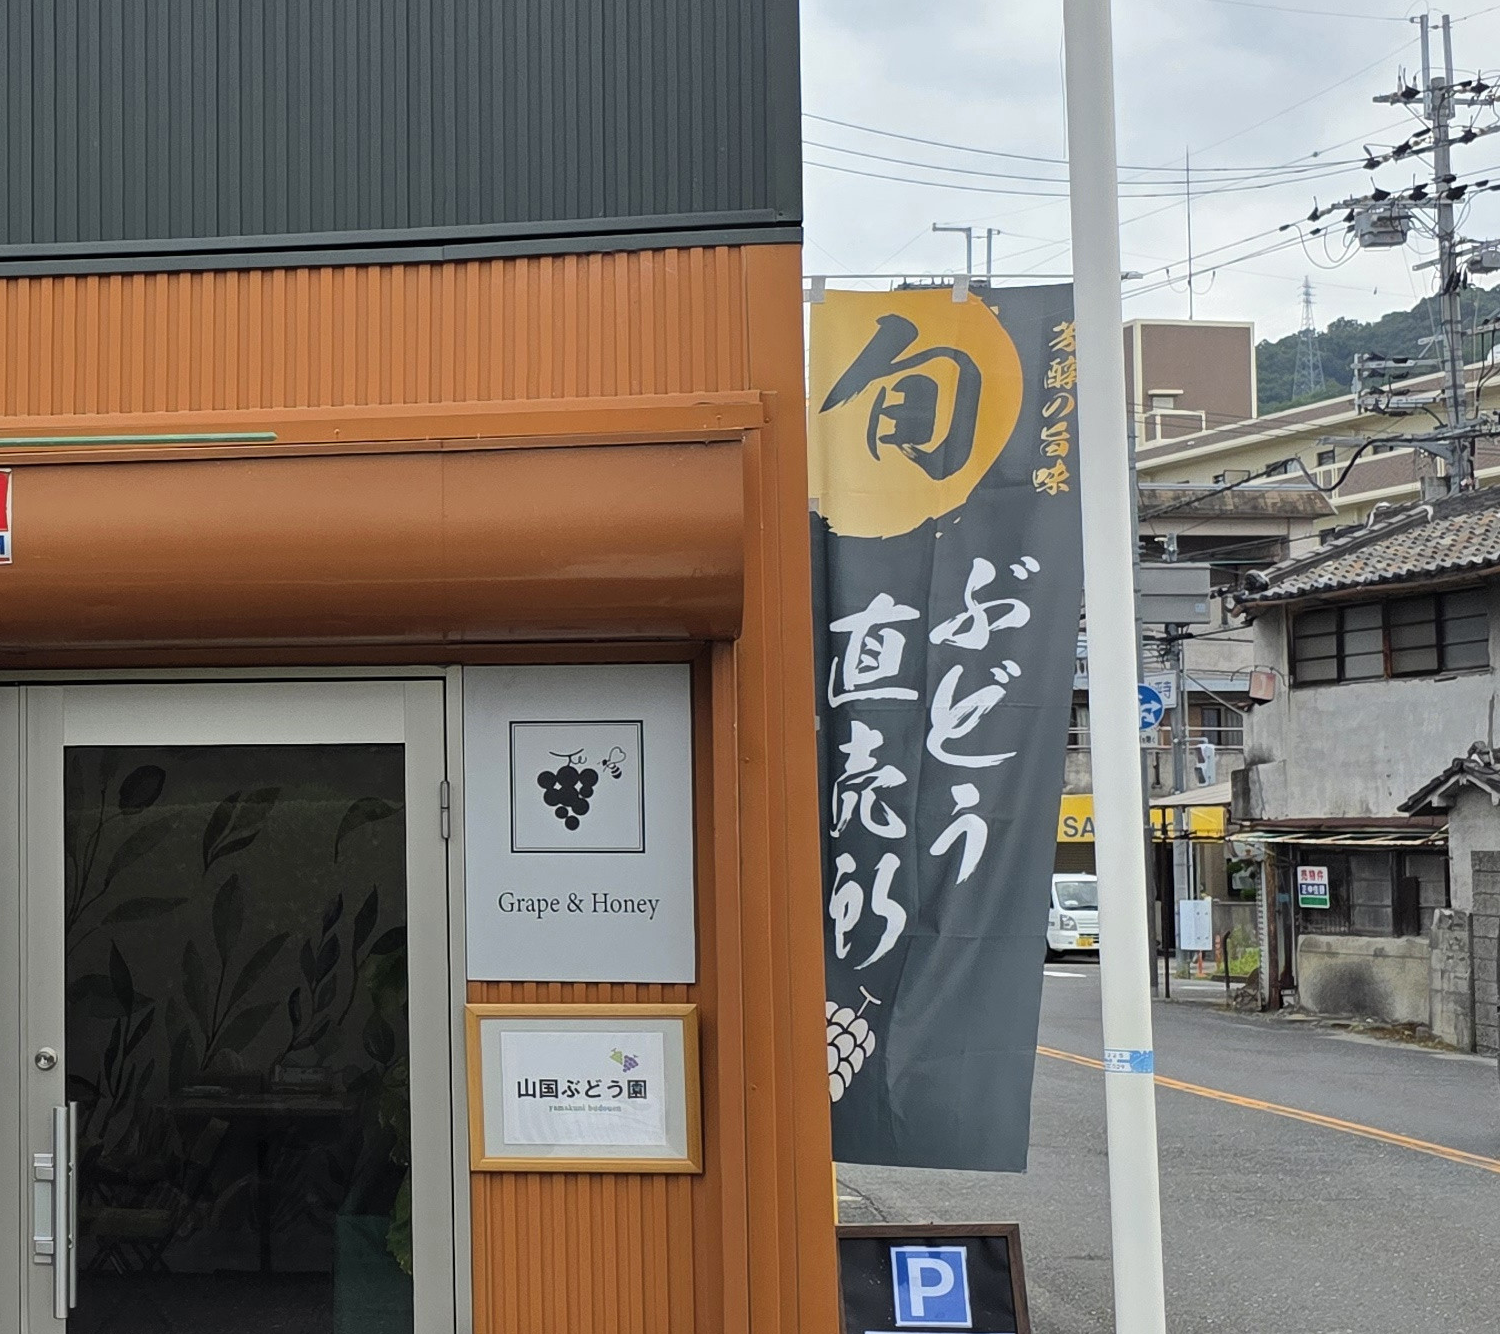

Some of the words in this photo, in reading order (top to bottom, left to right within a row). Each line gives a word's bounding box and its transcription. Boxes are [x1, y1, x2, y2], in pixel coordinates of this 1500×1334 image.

[819, 313, 983, 480] 旬
[926, 556, 1041, 885] ぶどう
[828, 592, 921, 970] 直売所
[497, 891, 560, 920] Grape
[566, 893, 585, 914] &
[591, 892, 660, 922] Honey
[516, 1078, 648, 1099] 山国ぶどう園
[905, 1258, 956, 1317] P
